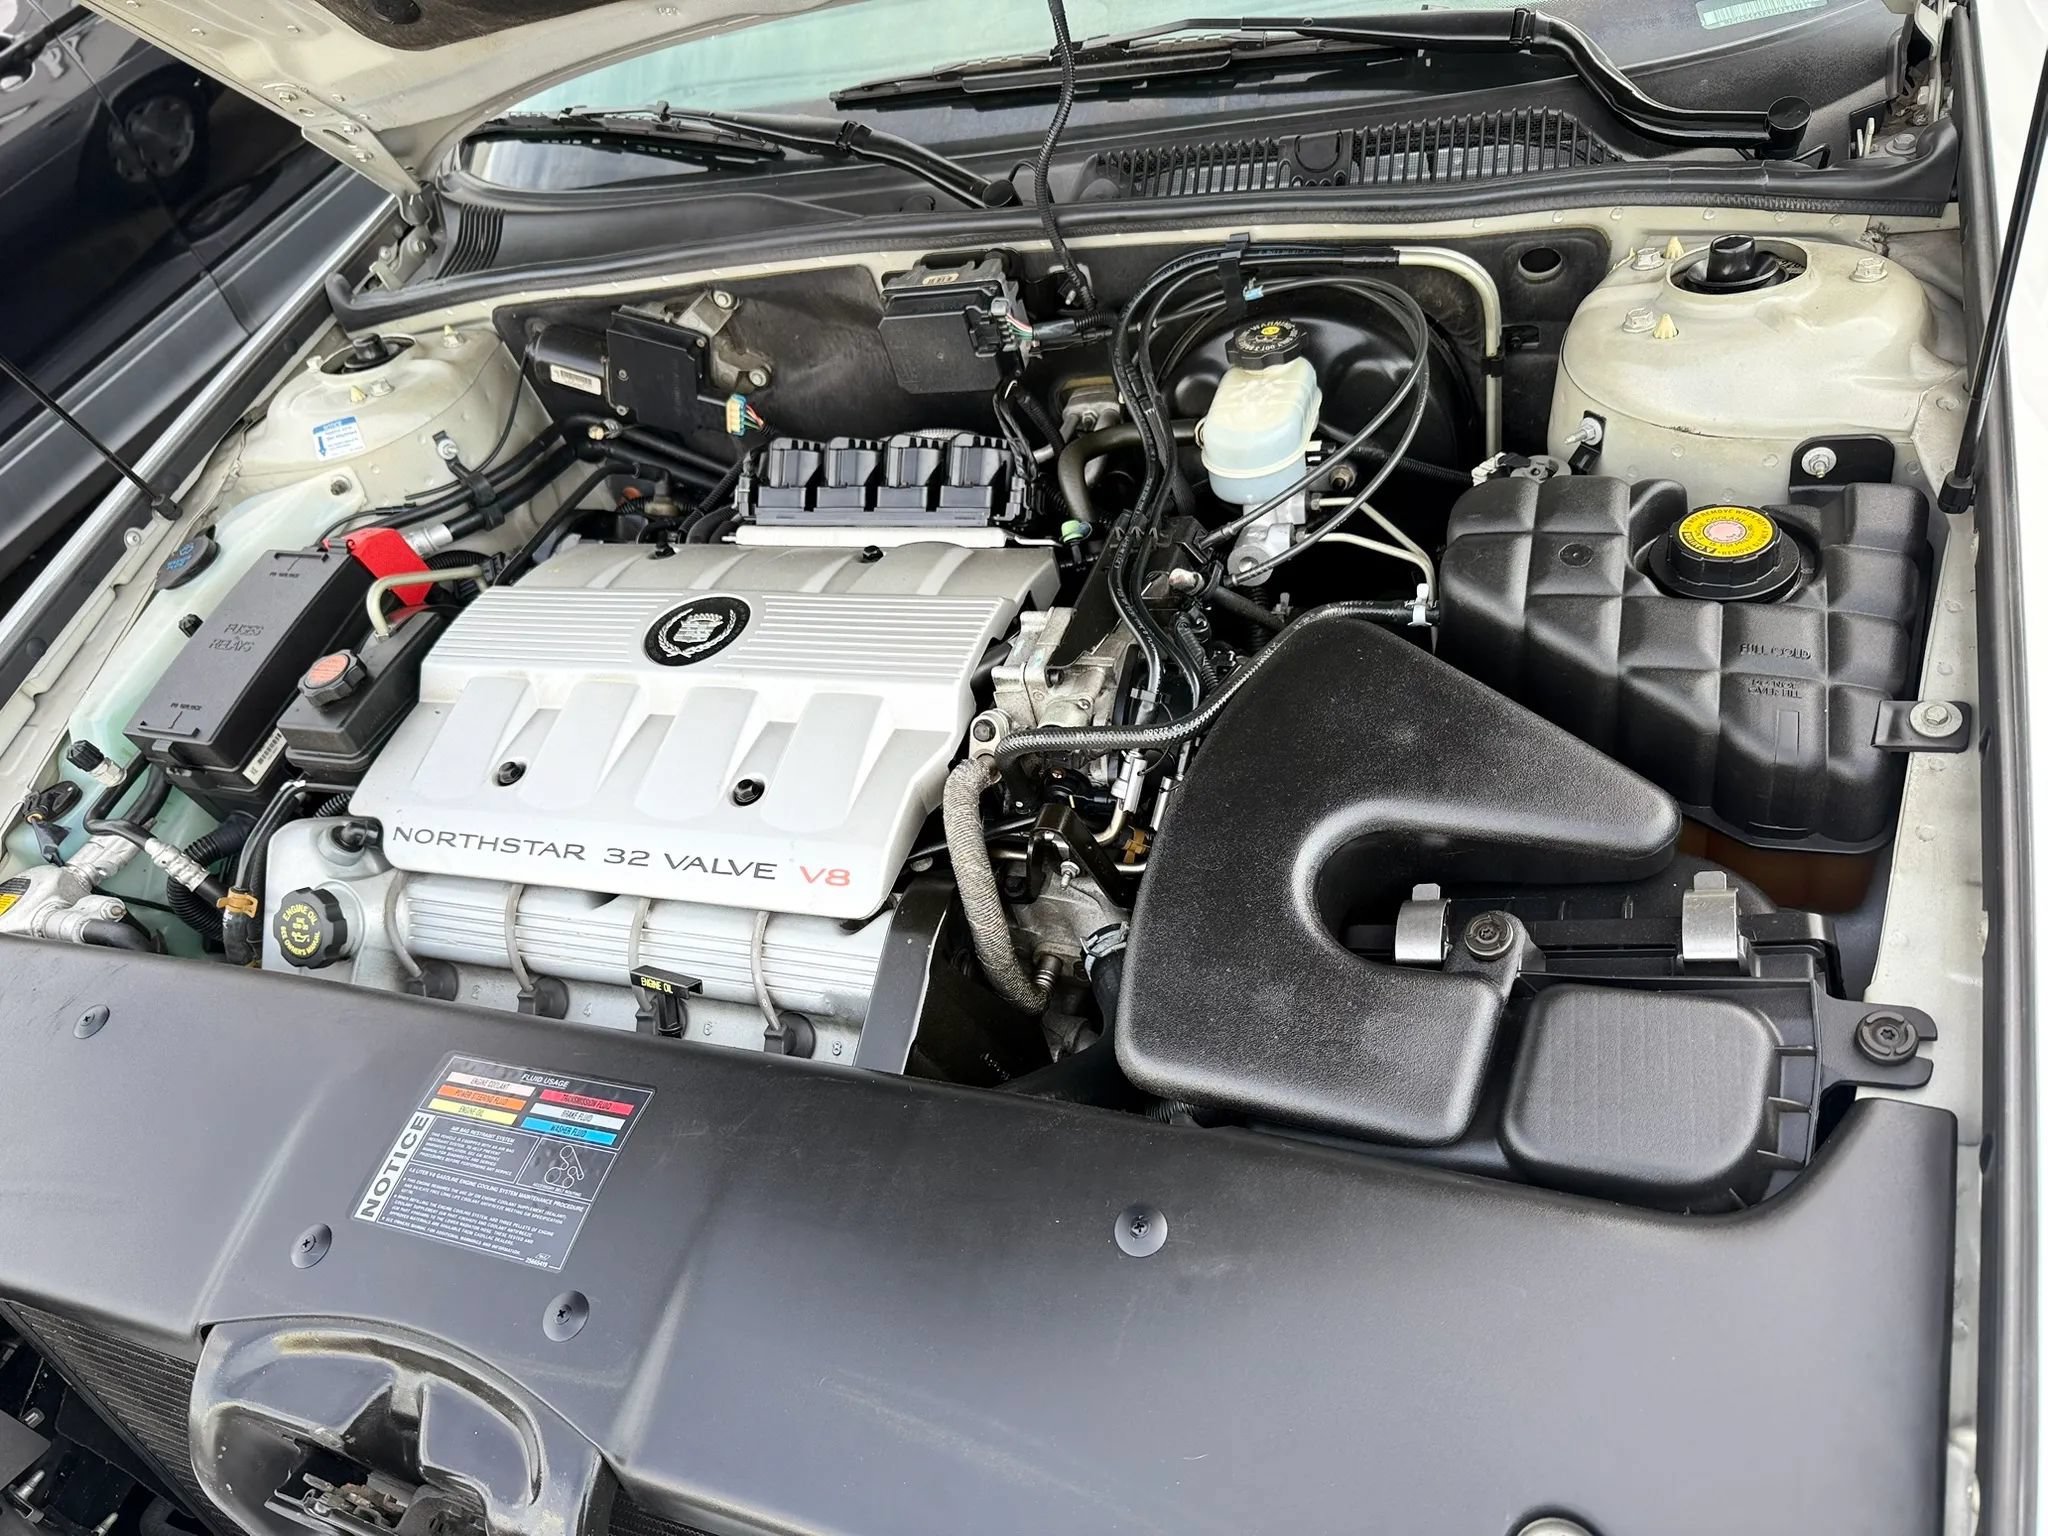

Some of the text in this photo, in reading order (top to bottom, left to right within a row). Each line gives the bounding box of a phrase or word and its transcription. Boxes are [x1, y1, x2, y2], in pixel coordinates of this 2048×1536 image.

[209, 639, 255, 652] RELAYS
[393, 826, 850, 887] NORTHSTAR 32 VALVE V8
[282, 904, 318, 925] ENGINE OIL
[641, 977, 674, 994] ENGINE OIL
[521, 1073, 570, 1087] FLUID USAGE
[560, 1109, 593, 1122] BRAKE FLUID
[550, 1124, 587, 1137] WASHER FLUID
[361, 1115, 430, 1218] NOTICE
